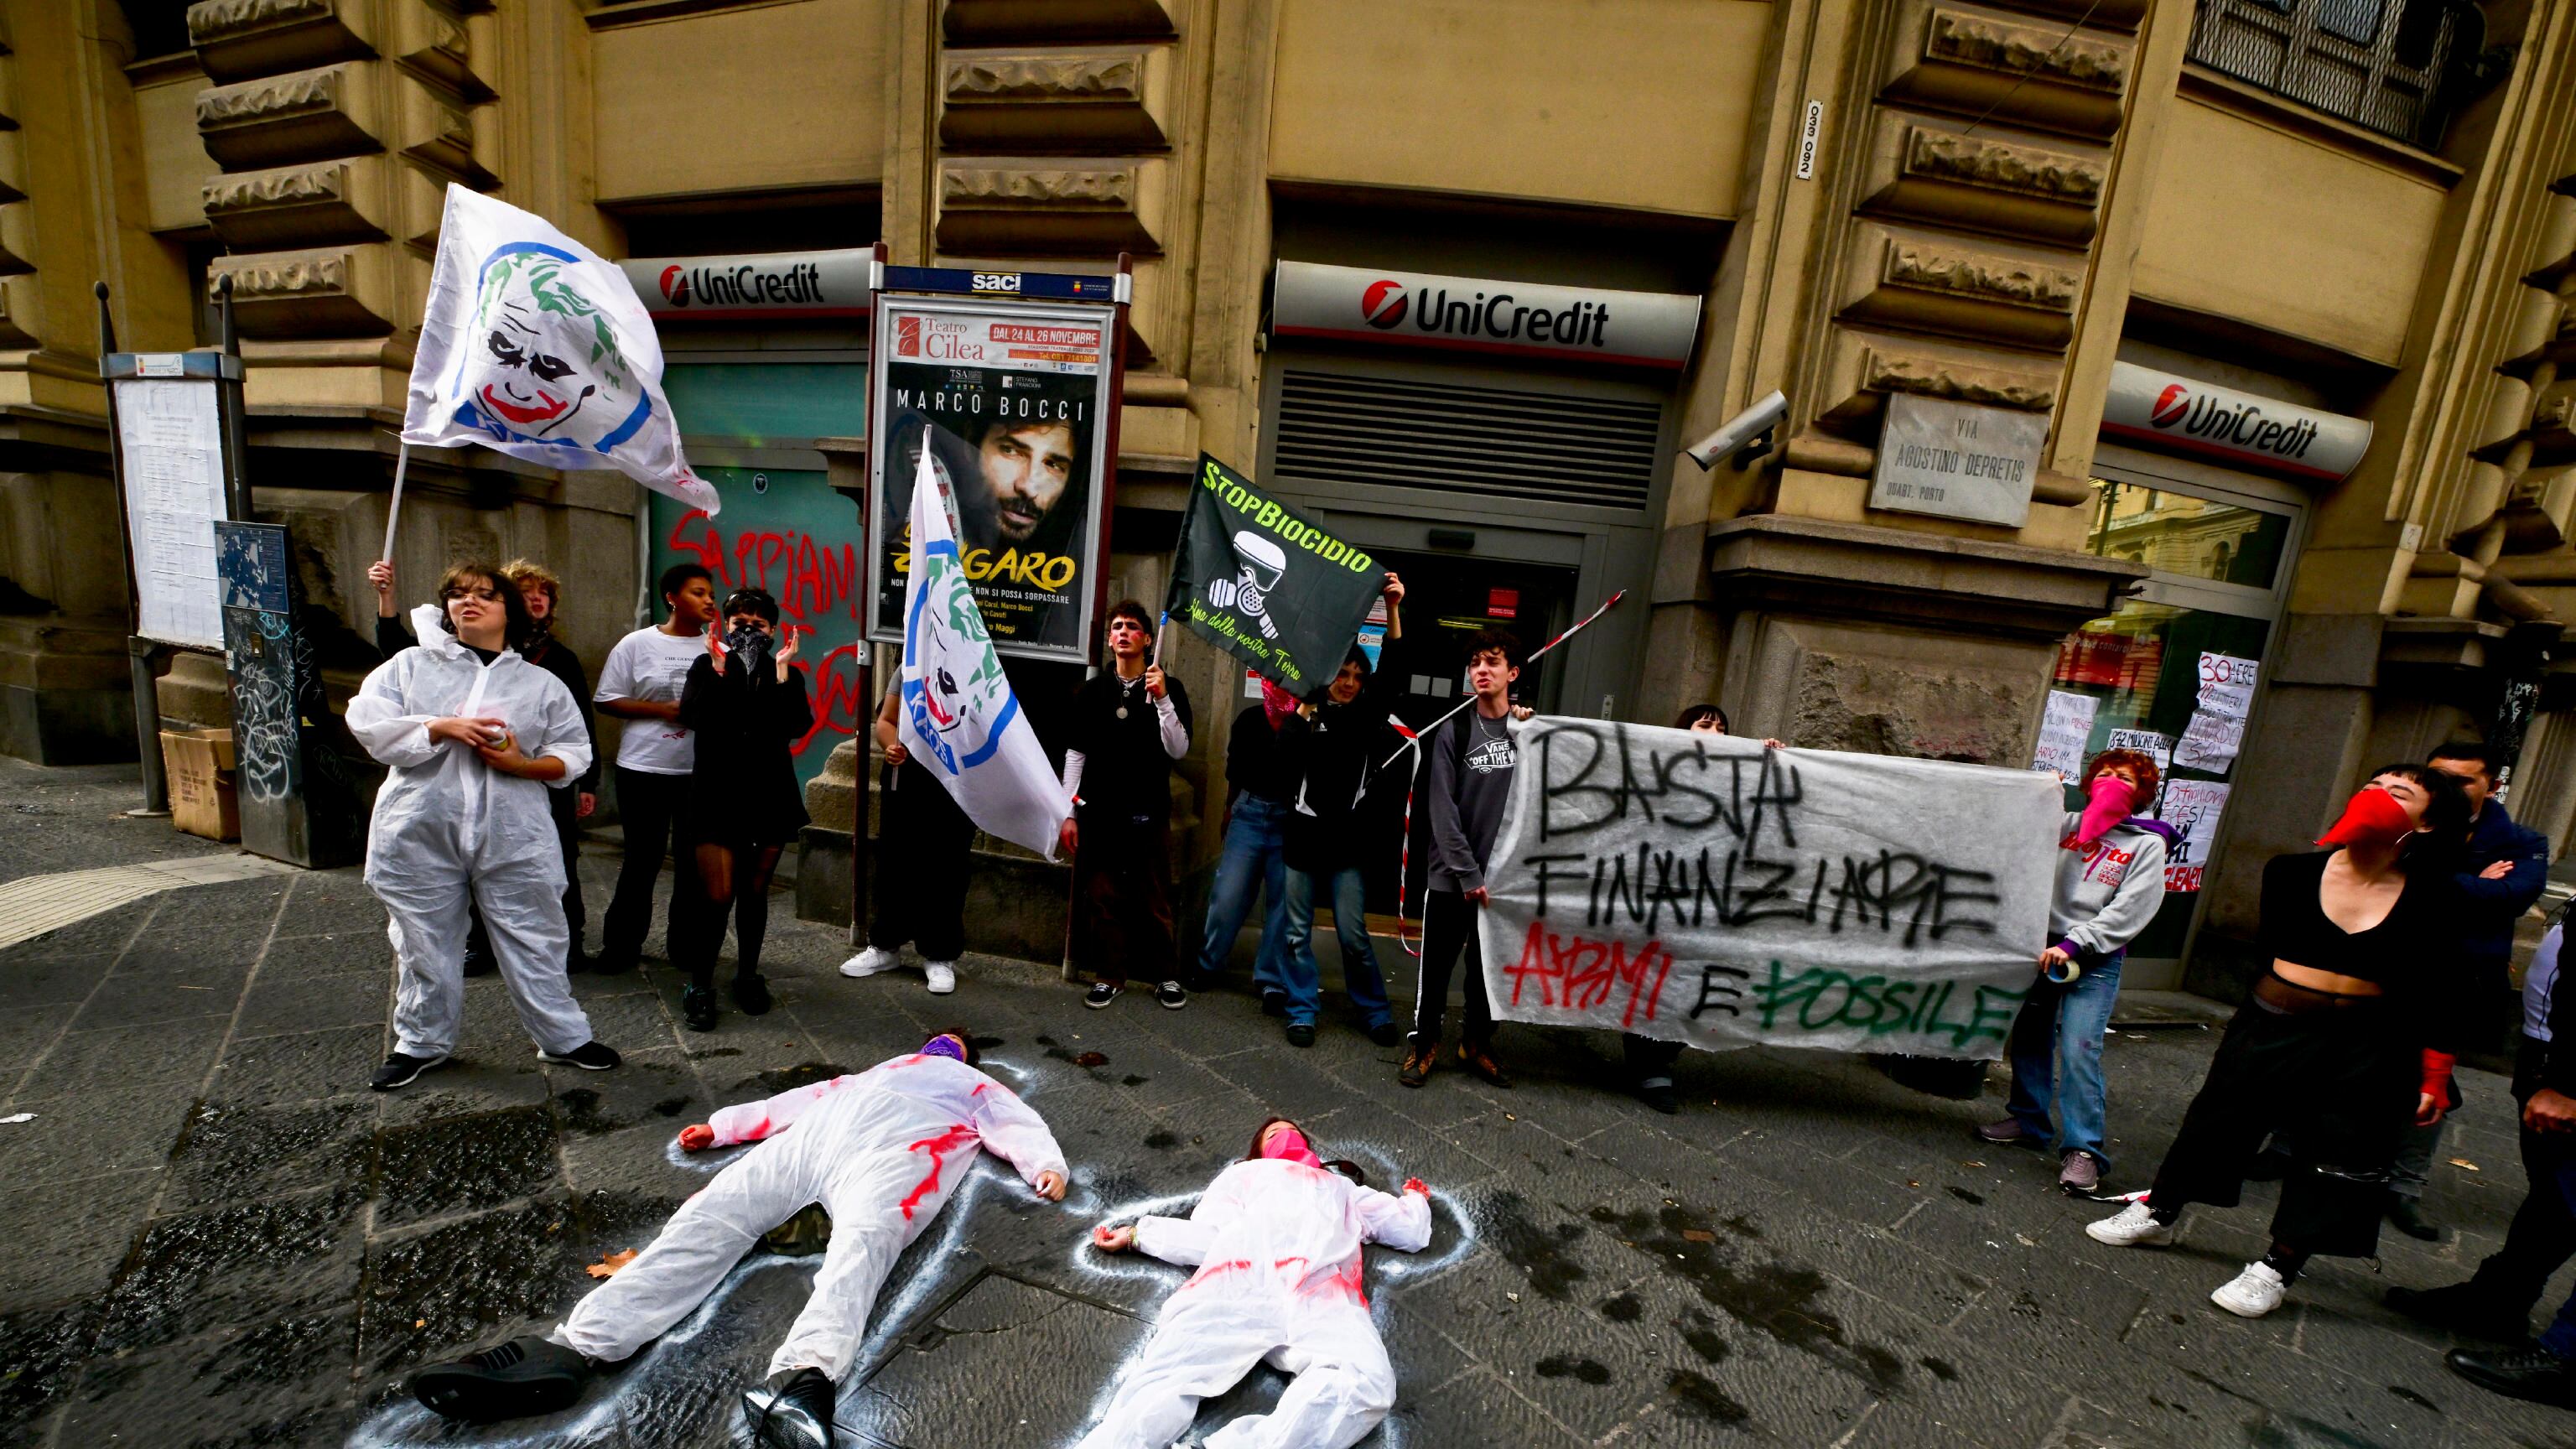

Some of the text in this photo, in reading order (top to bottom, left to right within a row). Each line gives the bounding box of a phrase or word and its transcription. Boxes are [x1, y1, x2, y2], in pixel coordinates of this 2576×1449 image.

[1800, 106, 1819, 173] 033 092
[693, 262, 824, 305] UniCredit
[973, 274, 1021, 291] saci
[926, 318, 968, 333] Teatro
[1416, 288, 1609, 347] UniCredit
[926, 333, 984, 361] Cilea
[993, 327, 1097, 345] DAL 24 AL 26 NOVEMBRE
[950, 370, 968, 378] TSA
[897, 389, 1083, 421] MARCO BOCCI
[1958, 419, 1977, 439] VIA
[2185, 394, 2318, 459] UniCredit
[1895, 444, 2025, 483] AGOSTINO DEPRETIS
[1919, 486, 1945, 502] PORTO
[891, 579, 904, 587] NON
[975, 588, 989, 596] NON
[1000, 590, 1022, 600] POSSA
[1025, 592, 1070, 604] SORPASSARE
[995, 623, 1015, 634] Maggi
[1208, 611, 1237, 637] della
[1237, 633, 1270, 658] nostra
[1275, 649, 1301, 680] Terra
[2201, 656, 2257, 686] 30 AEREI
[1489, 751, 1508, 766] THE
[1532, 722, 1803, 862] BASTA
[1524, 843, 2000, 948] FINANZIARE
[1504, 918, 1673, 1028] ARMI
[1690, 964, 1750, 1018] E
